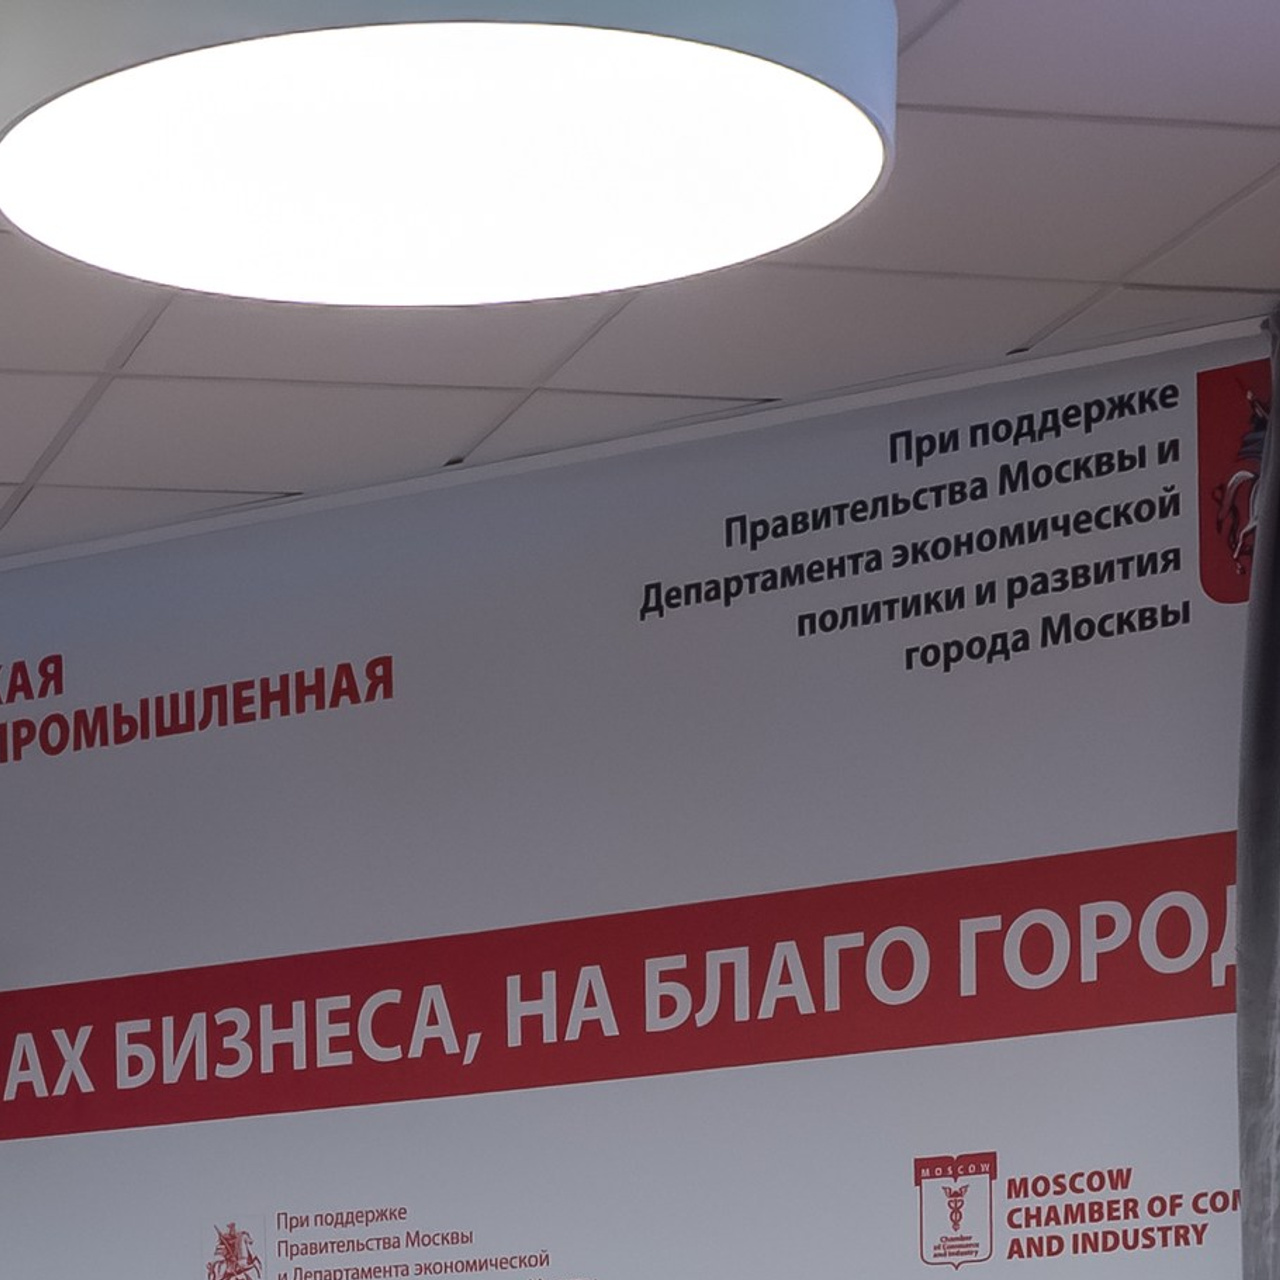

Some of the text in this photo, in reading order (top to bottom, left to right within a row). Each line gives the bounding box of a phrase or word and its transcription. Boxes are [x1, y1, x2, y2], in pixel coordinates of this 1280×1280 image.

[889, 381, 1180, 466] При поддержке
[723, 437, 1181, 550] Правительства Москвы и
[638, 489, 1182, 621] Департамента экономической
[797, 546, 1183, 638] политики и развития
[904, 599, 1191, 673] города Москвы
[115, 984, 481, 1091] БИЗНЕСА,
[506, 964, 619, 1049] НА
[644, 925, 932, 1035] БЛАГО
[921, 1163, 990, 1178] MOSCOW
[1007, 1168, 1133, 1199] MOSCOW
[277, 1206, 408, 1233] При поддержке
[1006, 1200, 1139, 1229] CHAMBER
[1147, 1194, 1183, 1218] OF
[277, 1228, 473, 1259] Правительства Москвы
[1006, 1223, 1209, 1260] AND INDUSTRY
[414, 1250, 550, 1276] экономической
